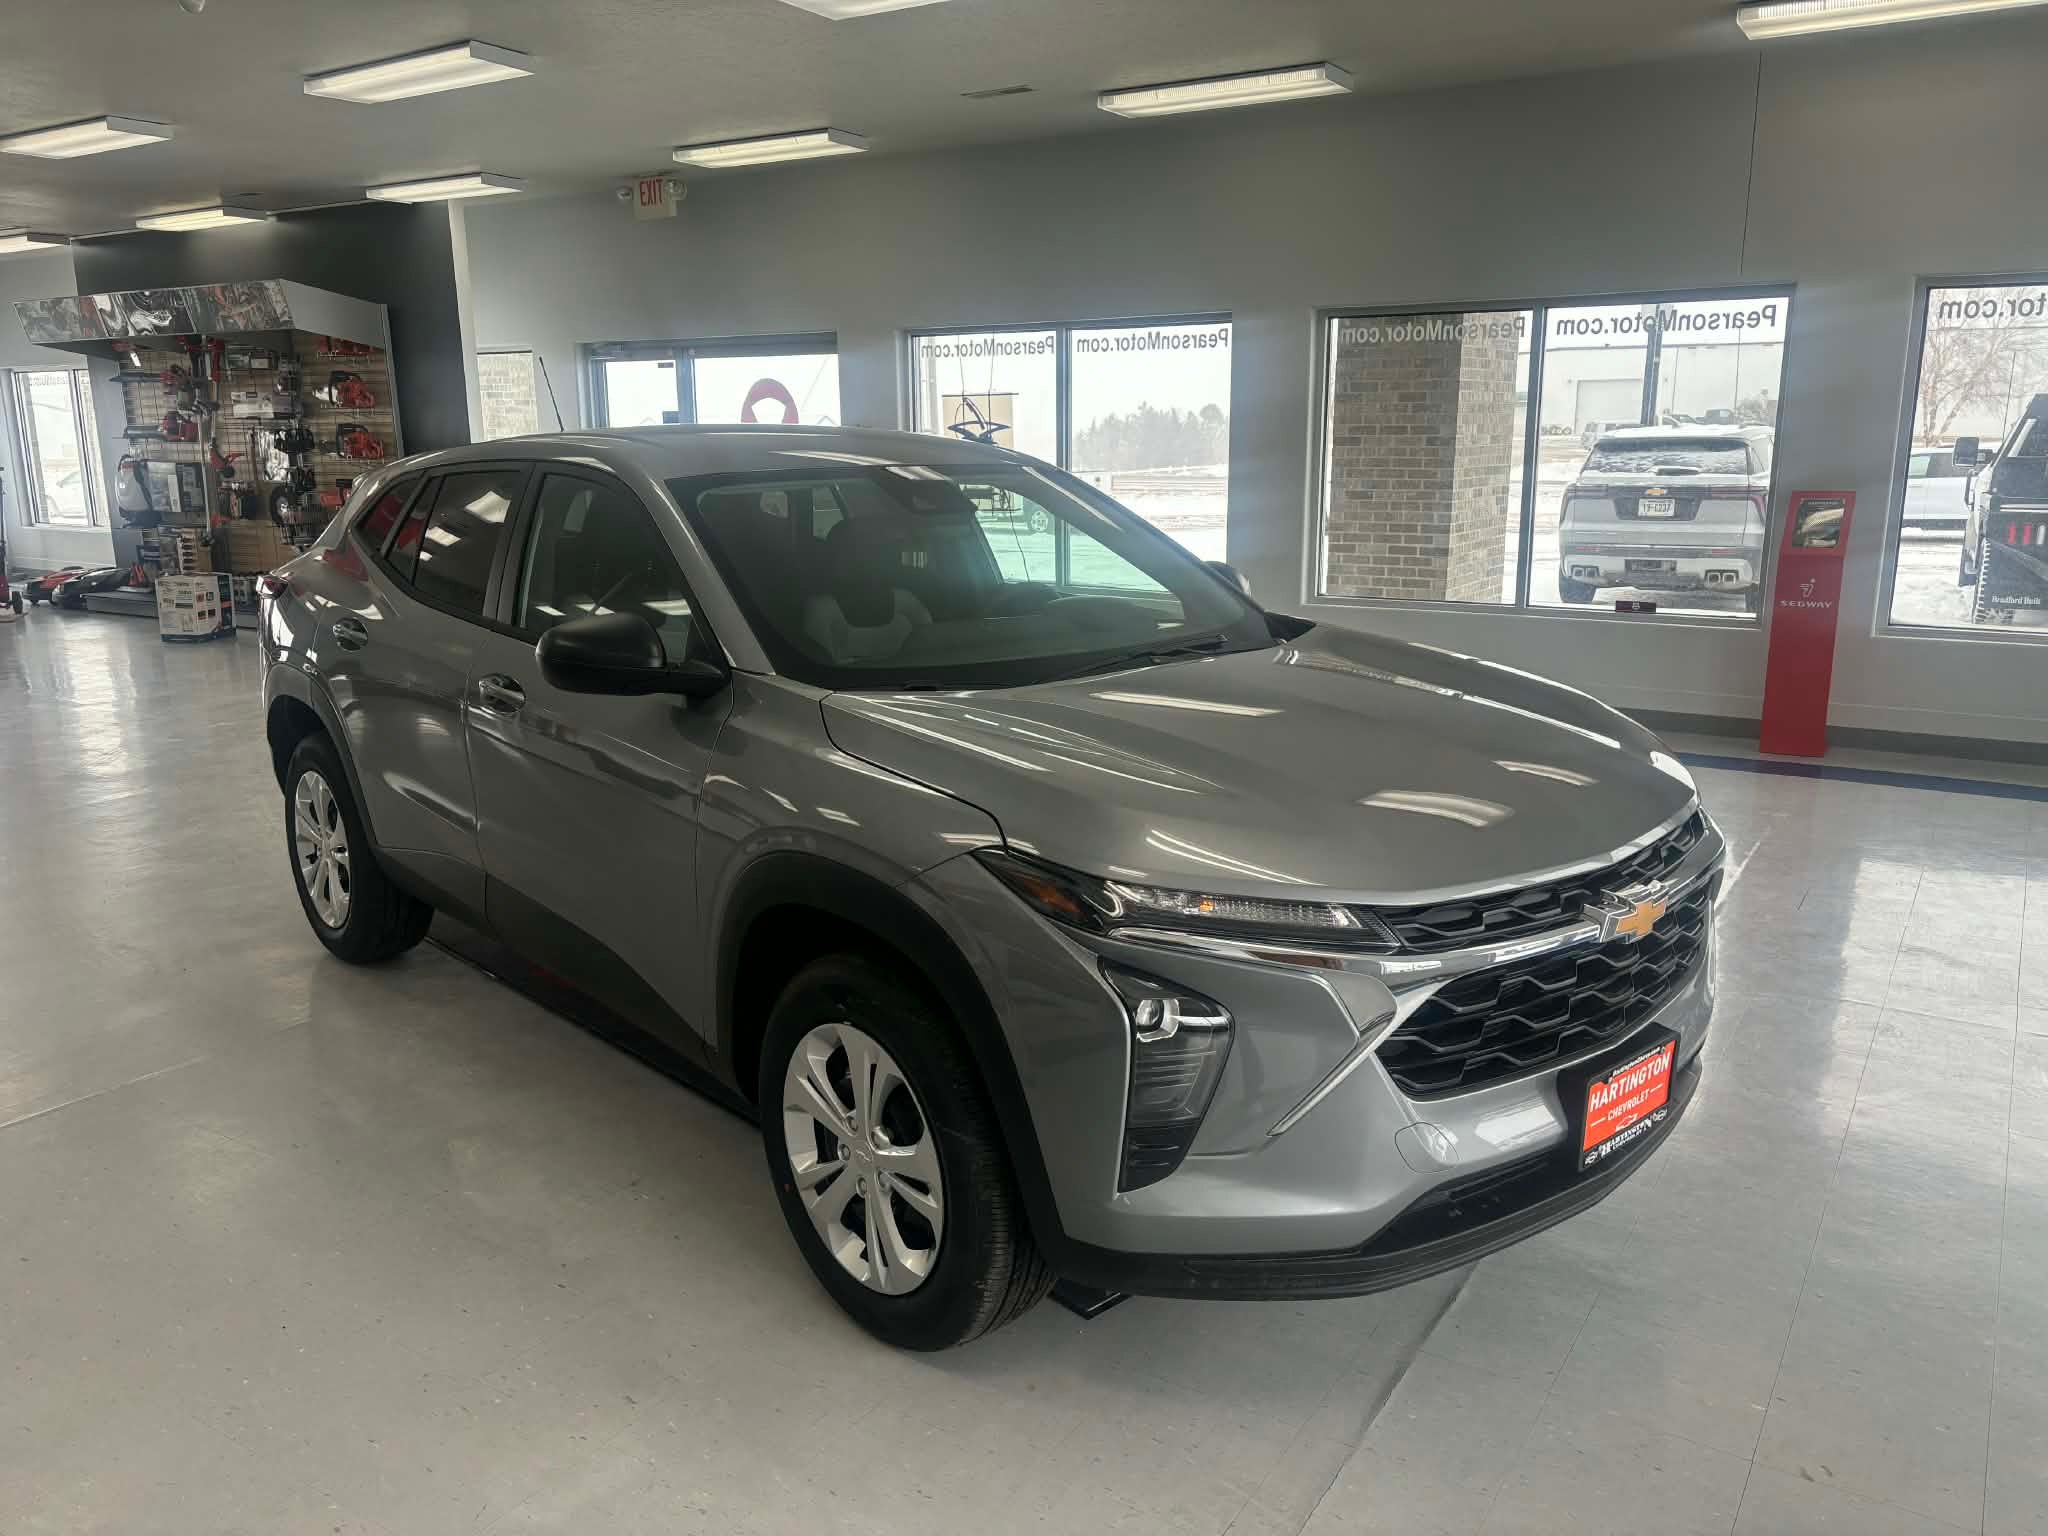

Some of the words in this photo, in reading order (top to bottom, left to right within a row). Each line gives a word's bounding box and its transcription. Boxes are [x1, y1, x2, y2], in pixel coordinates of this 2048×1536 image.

[639, 177, 664, 208] EXIT
[1780, 600, 1832, 608] SEGWAY
[1589, 1052, 1671, 1113] HARTINGTON
[1607, 1088, 1650, 1121] CHEVROLET
